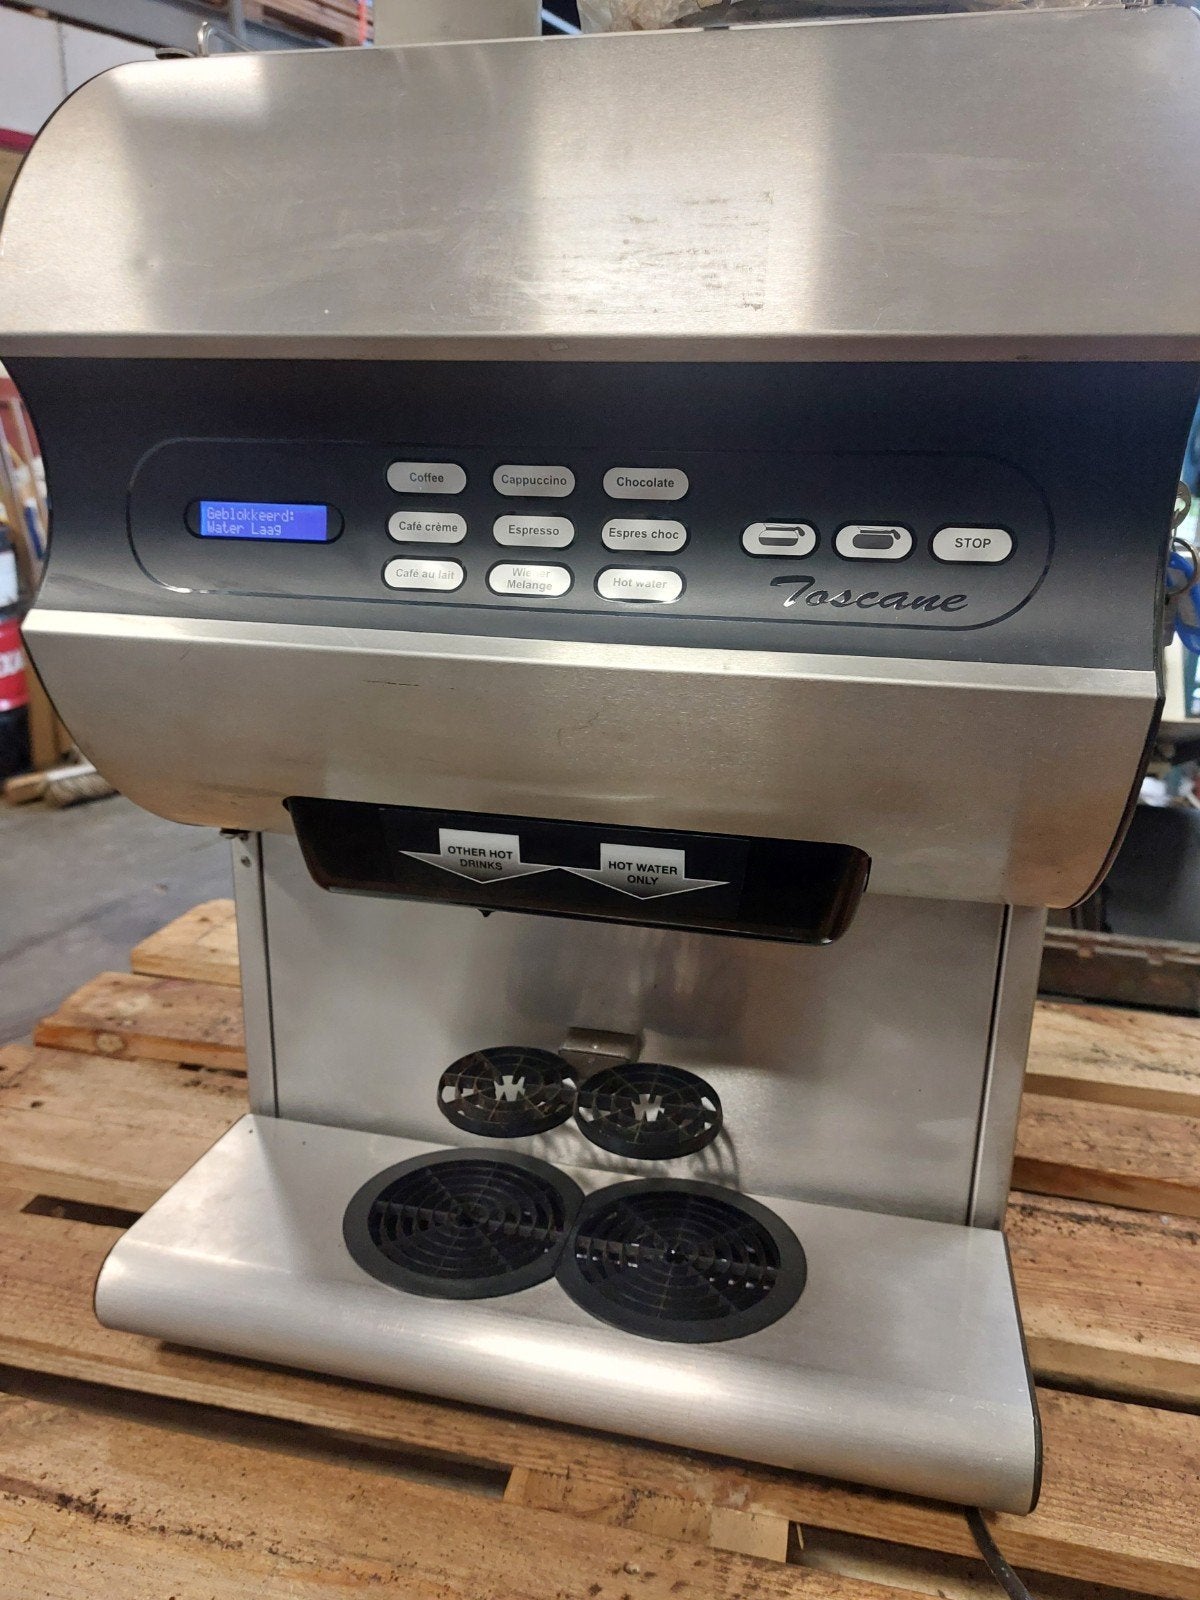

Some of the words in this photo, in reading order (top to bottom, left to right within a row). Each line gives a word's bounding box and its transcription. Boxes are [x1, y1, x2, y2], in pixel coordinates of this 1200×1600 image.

[409, 472, 444, 483] Coffee
[501, 474, 567, 487] Cappuccino
[616, 476, 675, 488] Chocolate
[206, 506, 295, 523] Geblokkeerd:
[206, 520, 244, 534] Water
[252, 522, 281, 535] Laag
[398, 521, 422, 532] Café
[425, 522, 458, 533] crème
[508, 524, 560, 538] Espresso
[608, 527, 648, 541] Espres
[651, 529, 679, 540] choc
[954, 537, 992, 549] STOP
[396, 568, 419, 578] Café
[421, 570, 435, 579] au
[438, 569, 454, 580] lait
[512, 567, 551, 578] Wieer
[507, 579, 553, 592] Melange
[613, 577, 632, 587] Hot
[635, 579, 667, 589] water
[769, 574, 968, 612] Toscane
[447, 845, 486, 858] OTHER
[489, 850, 513, 860] HOT
[459, 858, 503, 871] DRINKS
[608, 860, 634, 872] HOT
[636, 862, 678, 875] WATER
[626, 873, 659, 886] ONLY
